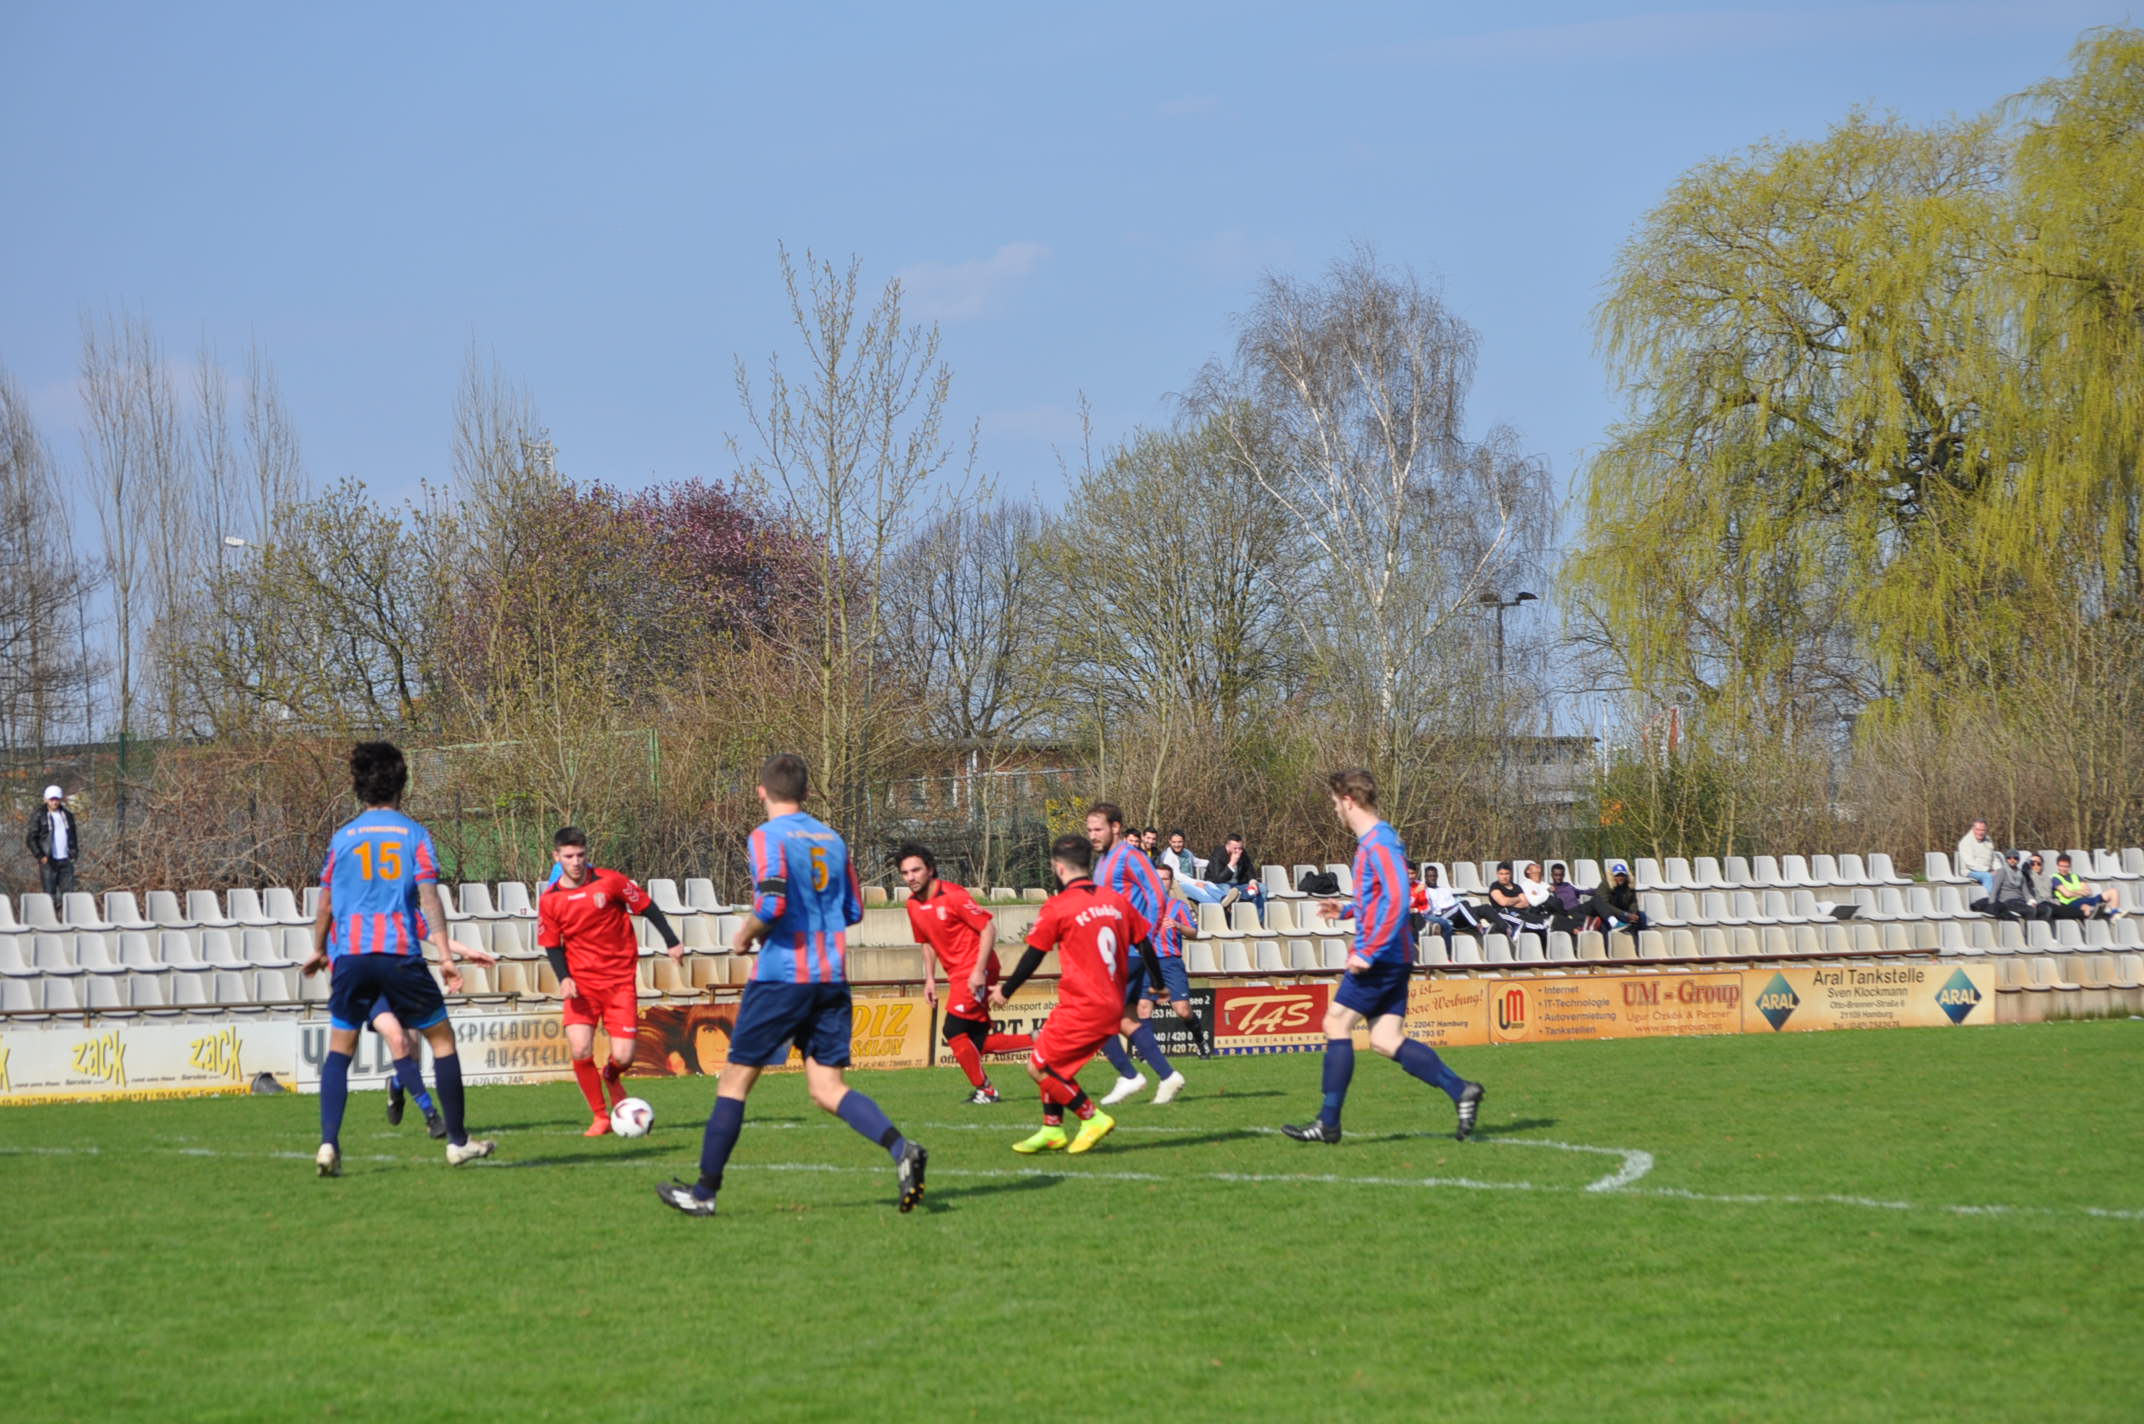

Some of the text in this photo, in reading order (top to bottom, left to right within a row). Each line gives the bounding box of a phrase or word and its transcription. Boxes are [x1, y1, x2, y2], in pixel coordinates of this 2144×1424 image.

[353, 841, 404, 881] 15
[810, 846, 829, 892] 5
[1812, 968, 1925, 986] Aral Tankstelle
[1544, 985, 1579, 994] Internet
[1621, 981, 1660, 1006] UM
[1679, 979, 1740, 1009] Group
[1827, 986, 1908, 998] Sven Klockmann
[1939, 988, 1976, 1005] ARAL
[1544, 998, 1610, 1009] IT-Technologie
[1760, 993, 1797, 1010] ARAL
[1224, 994, 1314, 1035] TAS
[1544, 1012, 1617, 1022] Autovermietung
[1171, 1031, 1186, 1041] 420
[1172, 1043, 1186, 1053] 420
